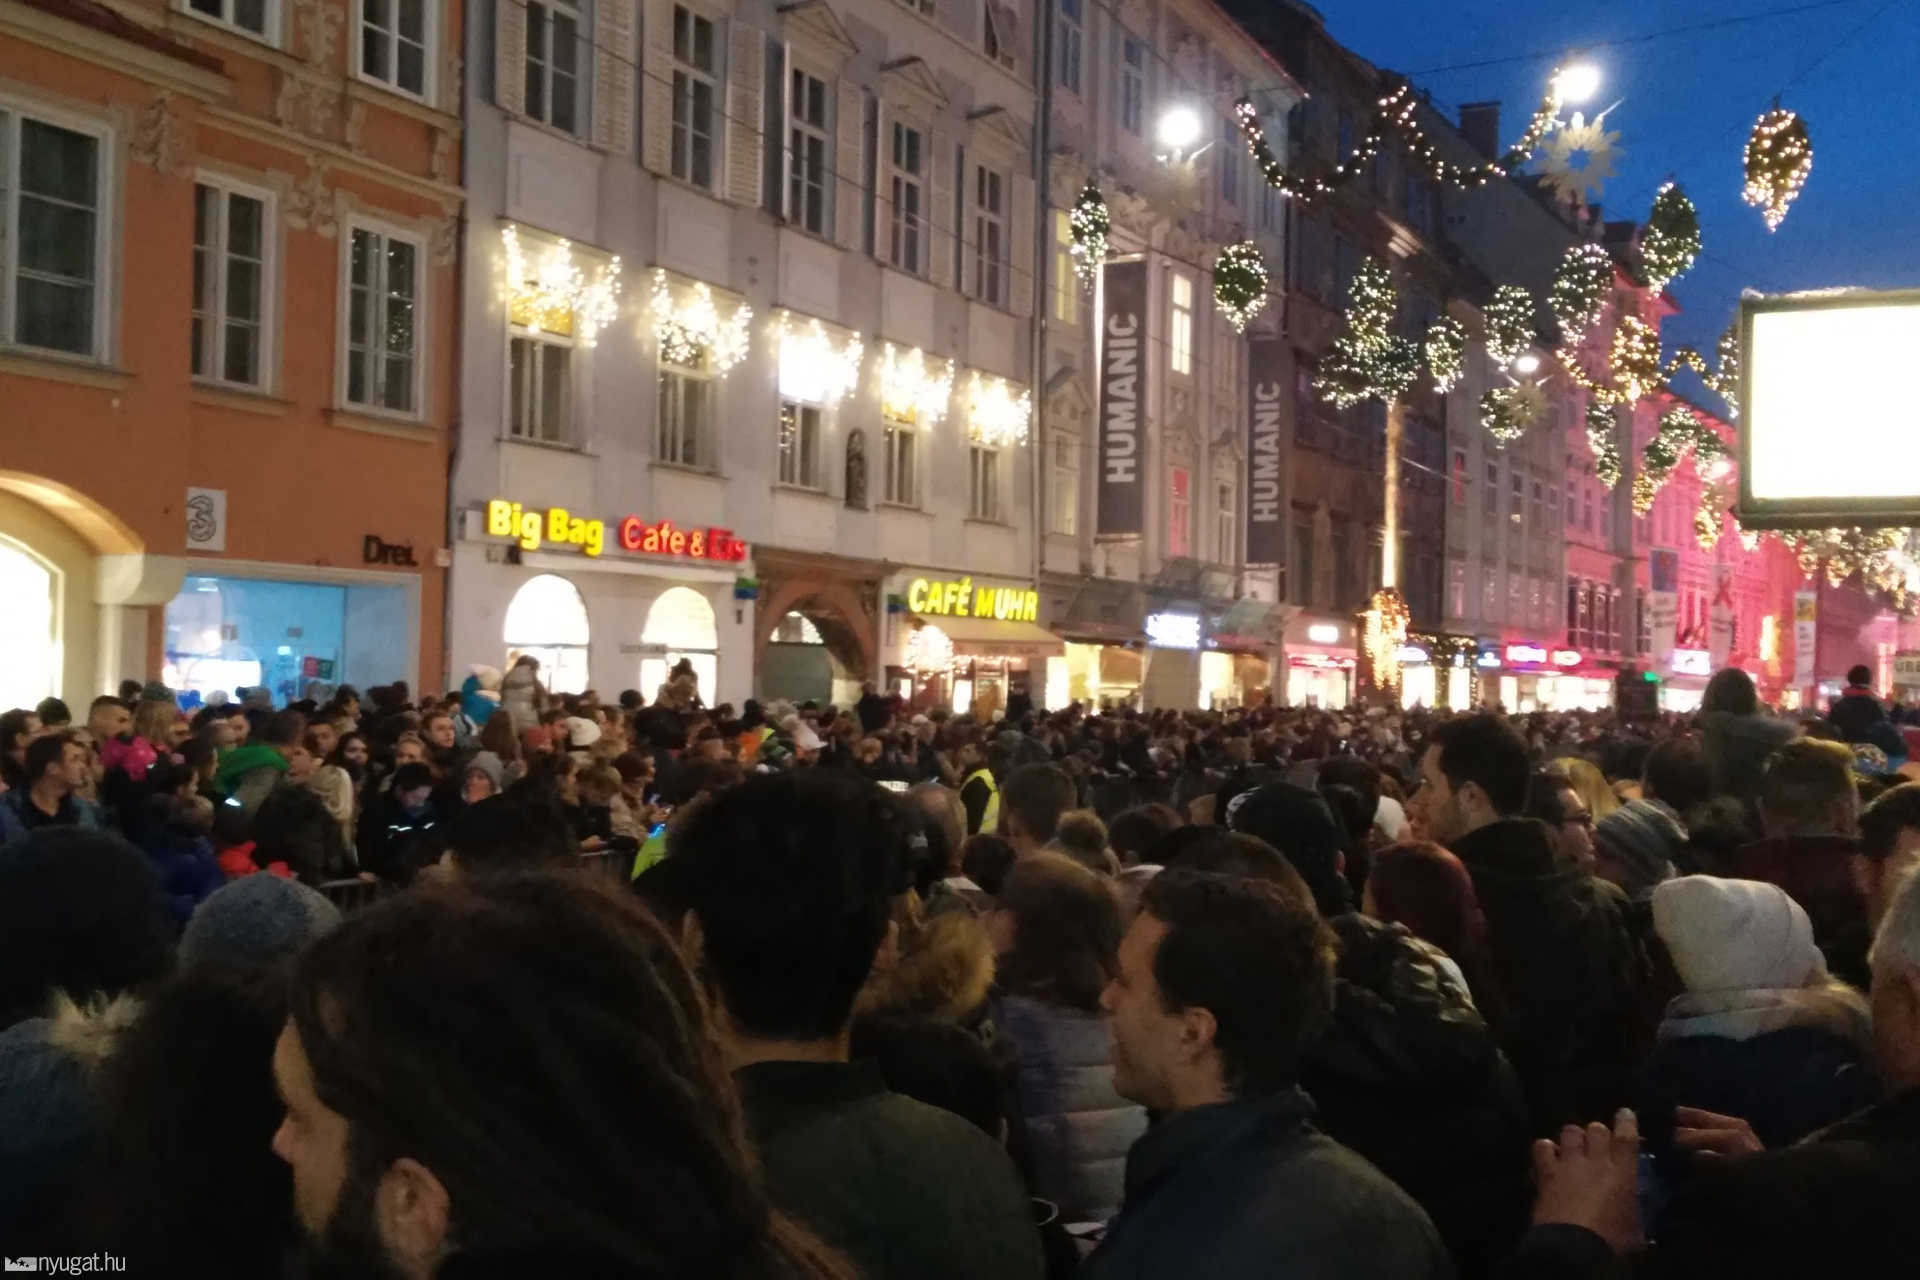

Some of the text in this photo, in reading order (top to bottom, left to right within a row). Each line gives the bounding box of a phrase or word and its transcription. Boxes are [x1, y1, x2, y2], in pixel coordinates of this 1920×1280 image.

[1106, 312, 1138, 483] HUMANIC
[1253, 381, 1281, 522] HUMANIC
[488, 499, 604, 556] Big Bag
[620, 515, 686, 553] Cafe
[689, 529, 704, 558] &
[908, 575, 1039, 622] CAFÉ MUHR
